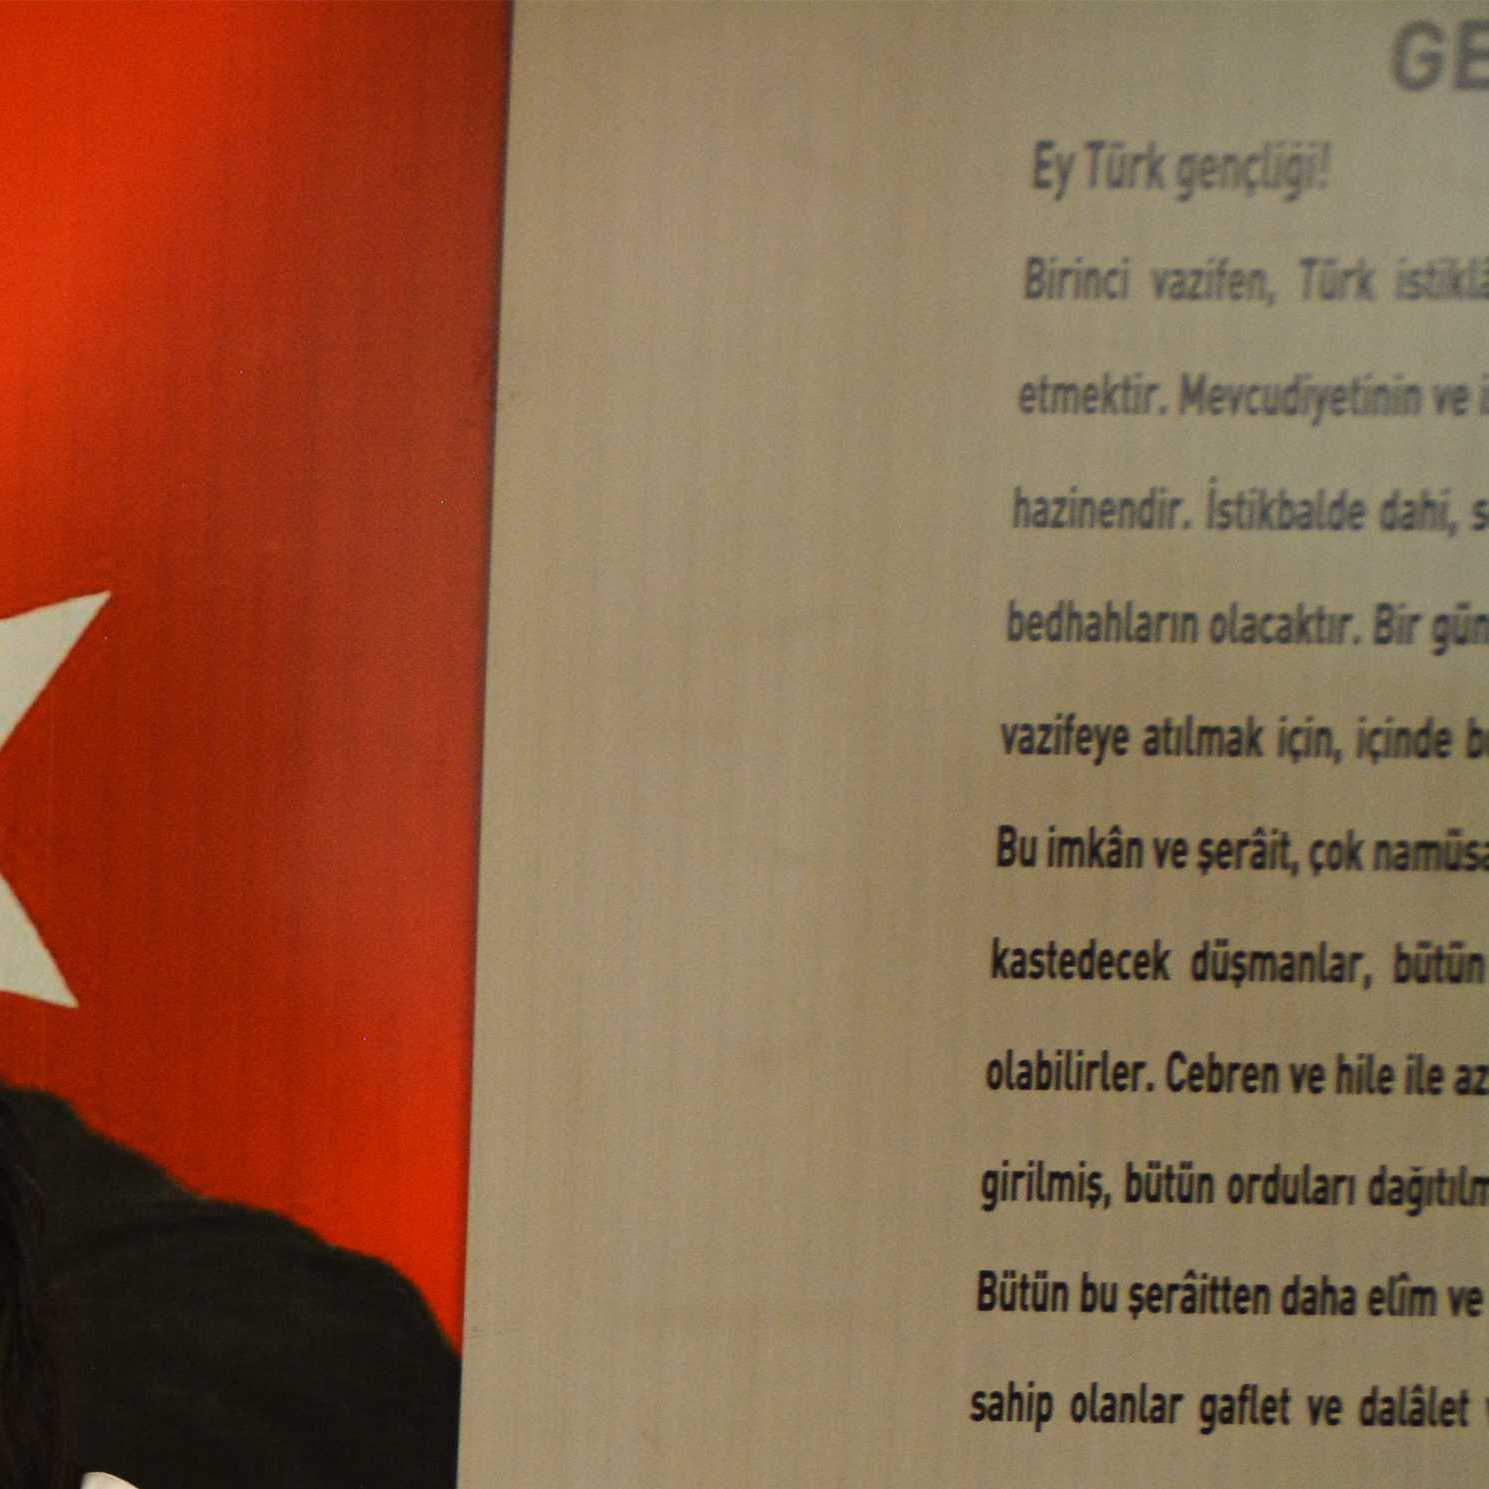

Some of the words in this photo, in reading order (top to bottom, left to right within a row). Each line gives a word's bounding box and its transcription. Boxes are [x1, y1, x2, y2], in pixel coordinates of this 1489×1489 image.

[1391, 18, 1489, 92] GE
[1031, 139, 1076, 202] Ey
[1083, 139, 1167, 190] Türk
[1175, 140, 1332, 204] gençliği!
[1023, 256, 1130, 301] Birinci
[1150, 257, 1277, 308] vazifen,
[1298, 256, 1376, 302] Türk
[1017, 372, 1169, 417] etmektir.
[1177, 372, 1425, 428] Mevcudiyetinin
[1432, 384, 1471, 416] ve
[1012, 485, 1192, 531] hazinendir.
[1205, 476, 1369, 532] İstikbalde
[1378, 487, 1460, 538] dahi,
[1006, 599, 1200, 645] bedhahların
[1208, 601, 1363, 646] olacaktır.
[1373, 601, 1424, 646] Bir
[1000, 712, 1132, 767] vazifeye
[1140, 714, 1266, 758] atılmak
[1276, 715, 1344, 766] için,
[1355, 715, 1455, 766] içinde
[1464, 716, 1489, 760] b
[995, 824, 1039, 869] Bu
[1046, 825, 1145, 870] imkân
[1151, 838, 1191, 870] ve
[1195, 826, 1301, 879] şerâit,
[1307, 827, 1366, 878] çok
[989, 936, 1174, 982] kastedecek
[1189, 937, 1374, 992] düşmanlar,
[1392, 940, 1487, 986] bütün
[984, 1048, 1157, 1094] olabilirler.
[1165, 1050, 1281, 1096] Cebren
[1287, 1061, 1327, 1096] ve
[1333, 1052, 1397, 1096] hile
[1404, 1052, 1446, 1097] ile
[980, 1159, 1113, 1214] girilmiş,
[1124, 1160, 1216, 1206] bütün
[1225, 1162, 1357, 1207] orduları
[975, 1269, 1070, 1315] Bütün
[1078, 1270, 1120, 1315] bu
[1126, 1268, 1273, 1321] şerâitten
[1279, 1271, 1358, 1318] daha
[1446, 1286, 1485, 1319] ve
[968, 1380, 1056, 1434] sahip
[1069, 1381, 1186, 1426] olanlar
[1198, 1383, 1293, 1436] gaflet
[1306, 1395, 1344, 1428] ve
[1357, 1383, 1473, 1428] dalâlet
